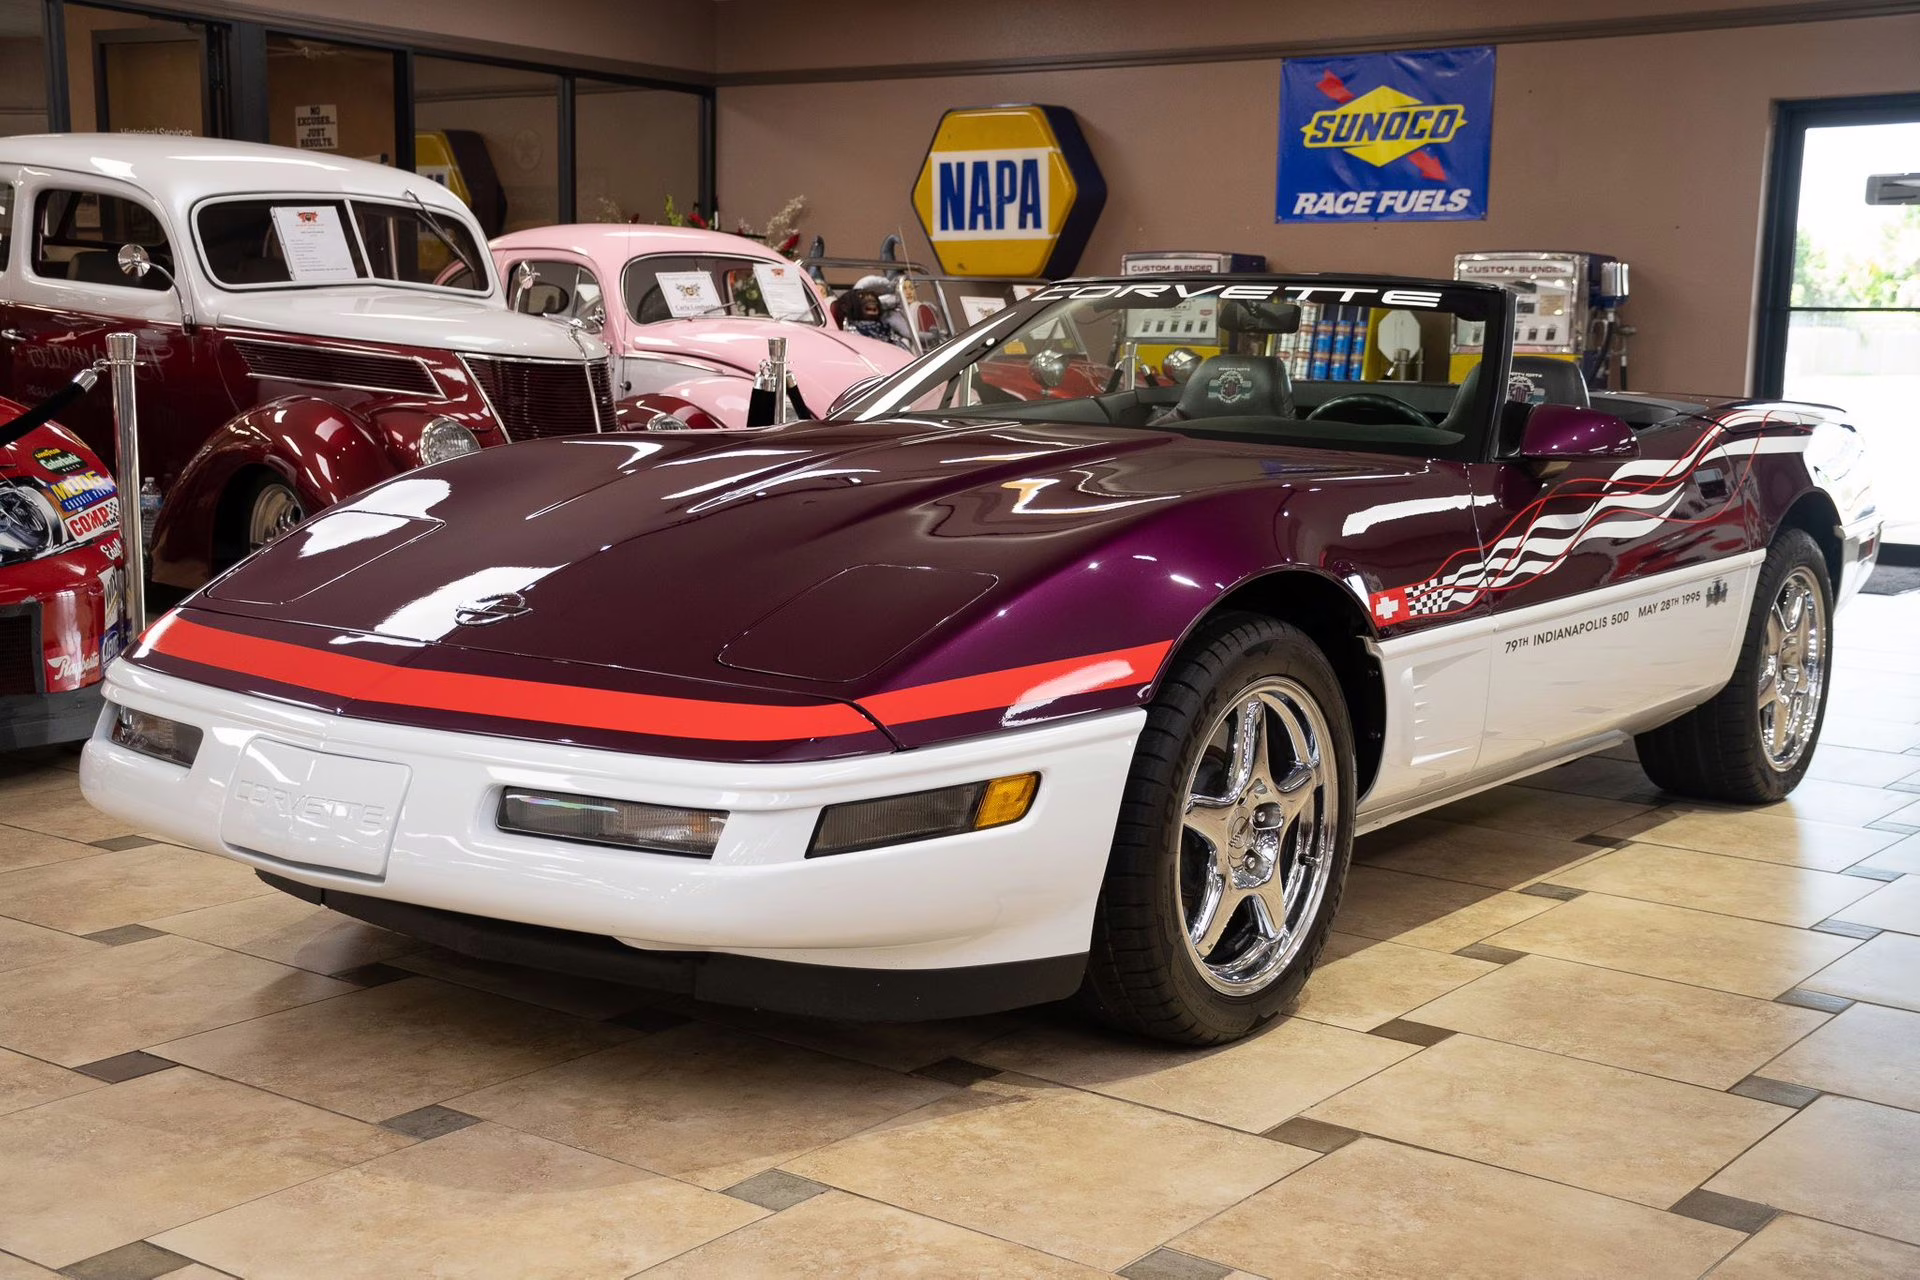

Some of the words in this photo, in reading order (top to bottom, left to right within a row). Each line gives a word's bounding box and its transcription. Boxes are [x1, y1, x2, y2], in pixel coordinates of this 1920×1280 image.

[310, 106, 320, 116] NO
[159, 127, 193, 137] Services
[306, 127, 326, 137] JUST
[1307, 107, 1461, 145] SUNOCO
[939, 158, 1042, 231] NAPA
[1293, 190, 1376, 215] RACE
[1376, 188, 1471, 214] FUELS
[1031, 284, 1443, 308] CORVETTE
[69, 506, 109, 537] COMP
[1505, 636, 1529, 654] 79TH
[1533, 616, 1608, 646] INDIANAPOLIS
[1610, 610, 1630, 625] 500
[1637, 602, 1659, 619] MAY
[1660, 597, 1680, 612] 28TH
[1681, 591, 1701, 606] 1995
[234, 779, 386, 826] CORVETTE
